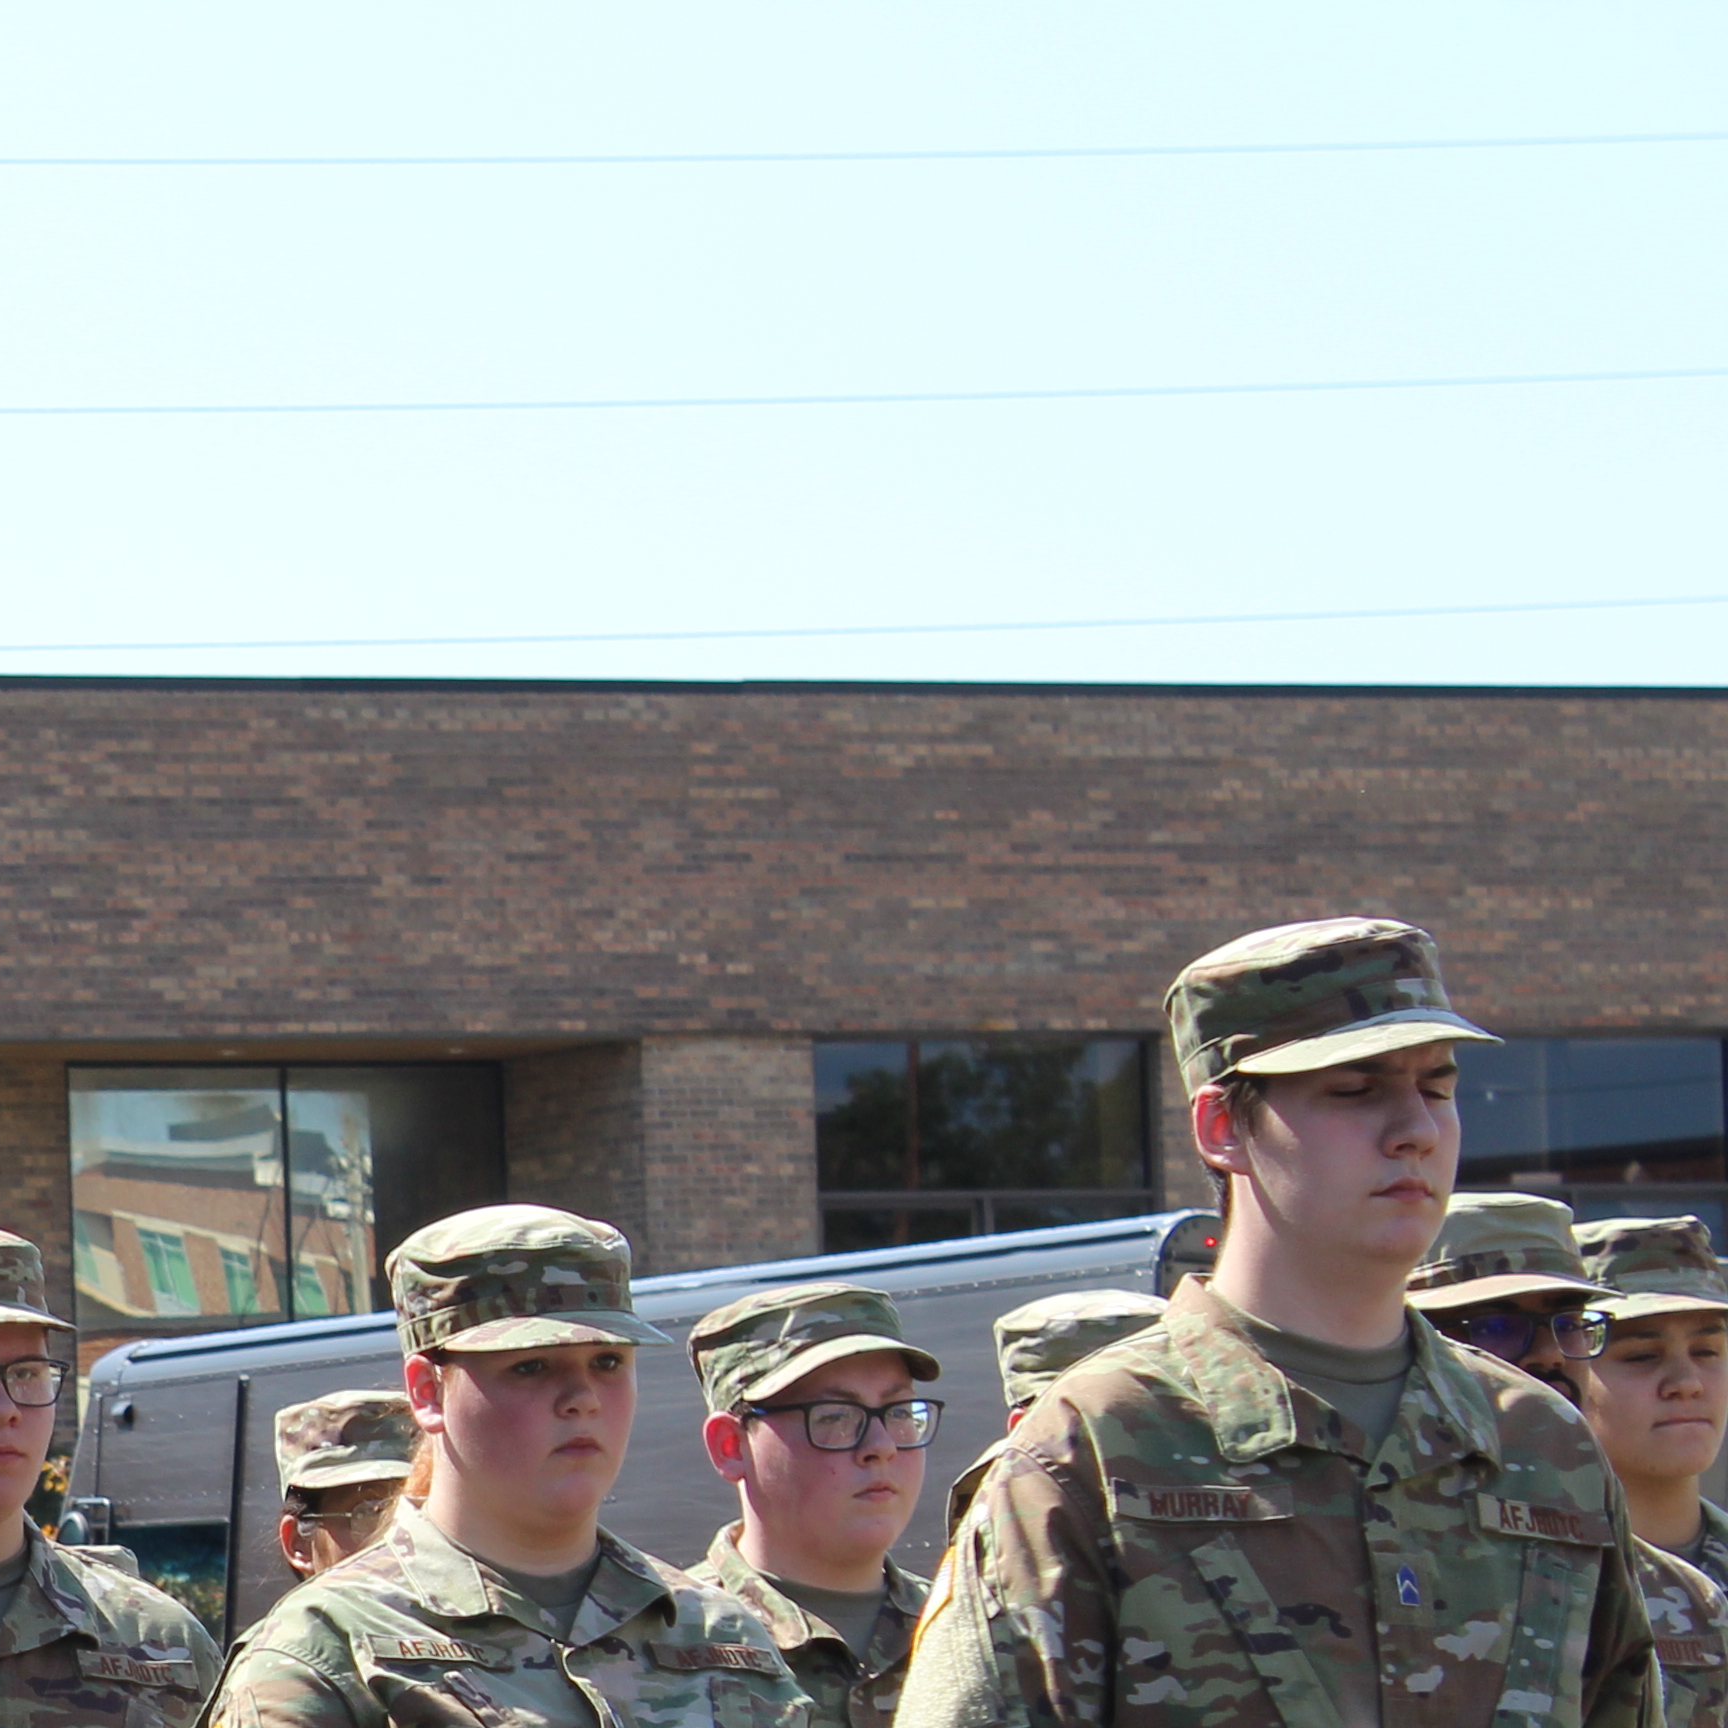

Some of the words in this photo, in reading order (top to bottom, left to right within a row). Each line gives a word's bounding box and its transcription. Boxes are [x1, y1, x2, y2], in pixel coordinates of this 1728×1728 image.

[1148, 1491, 1250, 1517] MURRAY
[1499, 1501, 1583, 1539] AFJROTC
[399, 1640, 490, 1663] AFJROTC
[676, 1645, 762, 1667] AFJROTC
[1656, 1640, 1704, 1661] ROTC
[100, 1656, 175, 1682] AFJROTC
